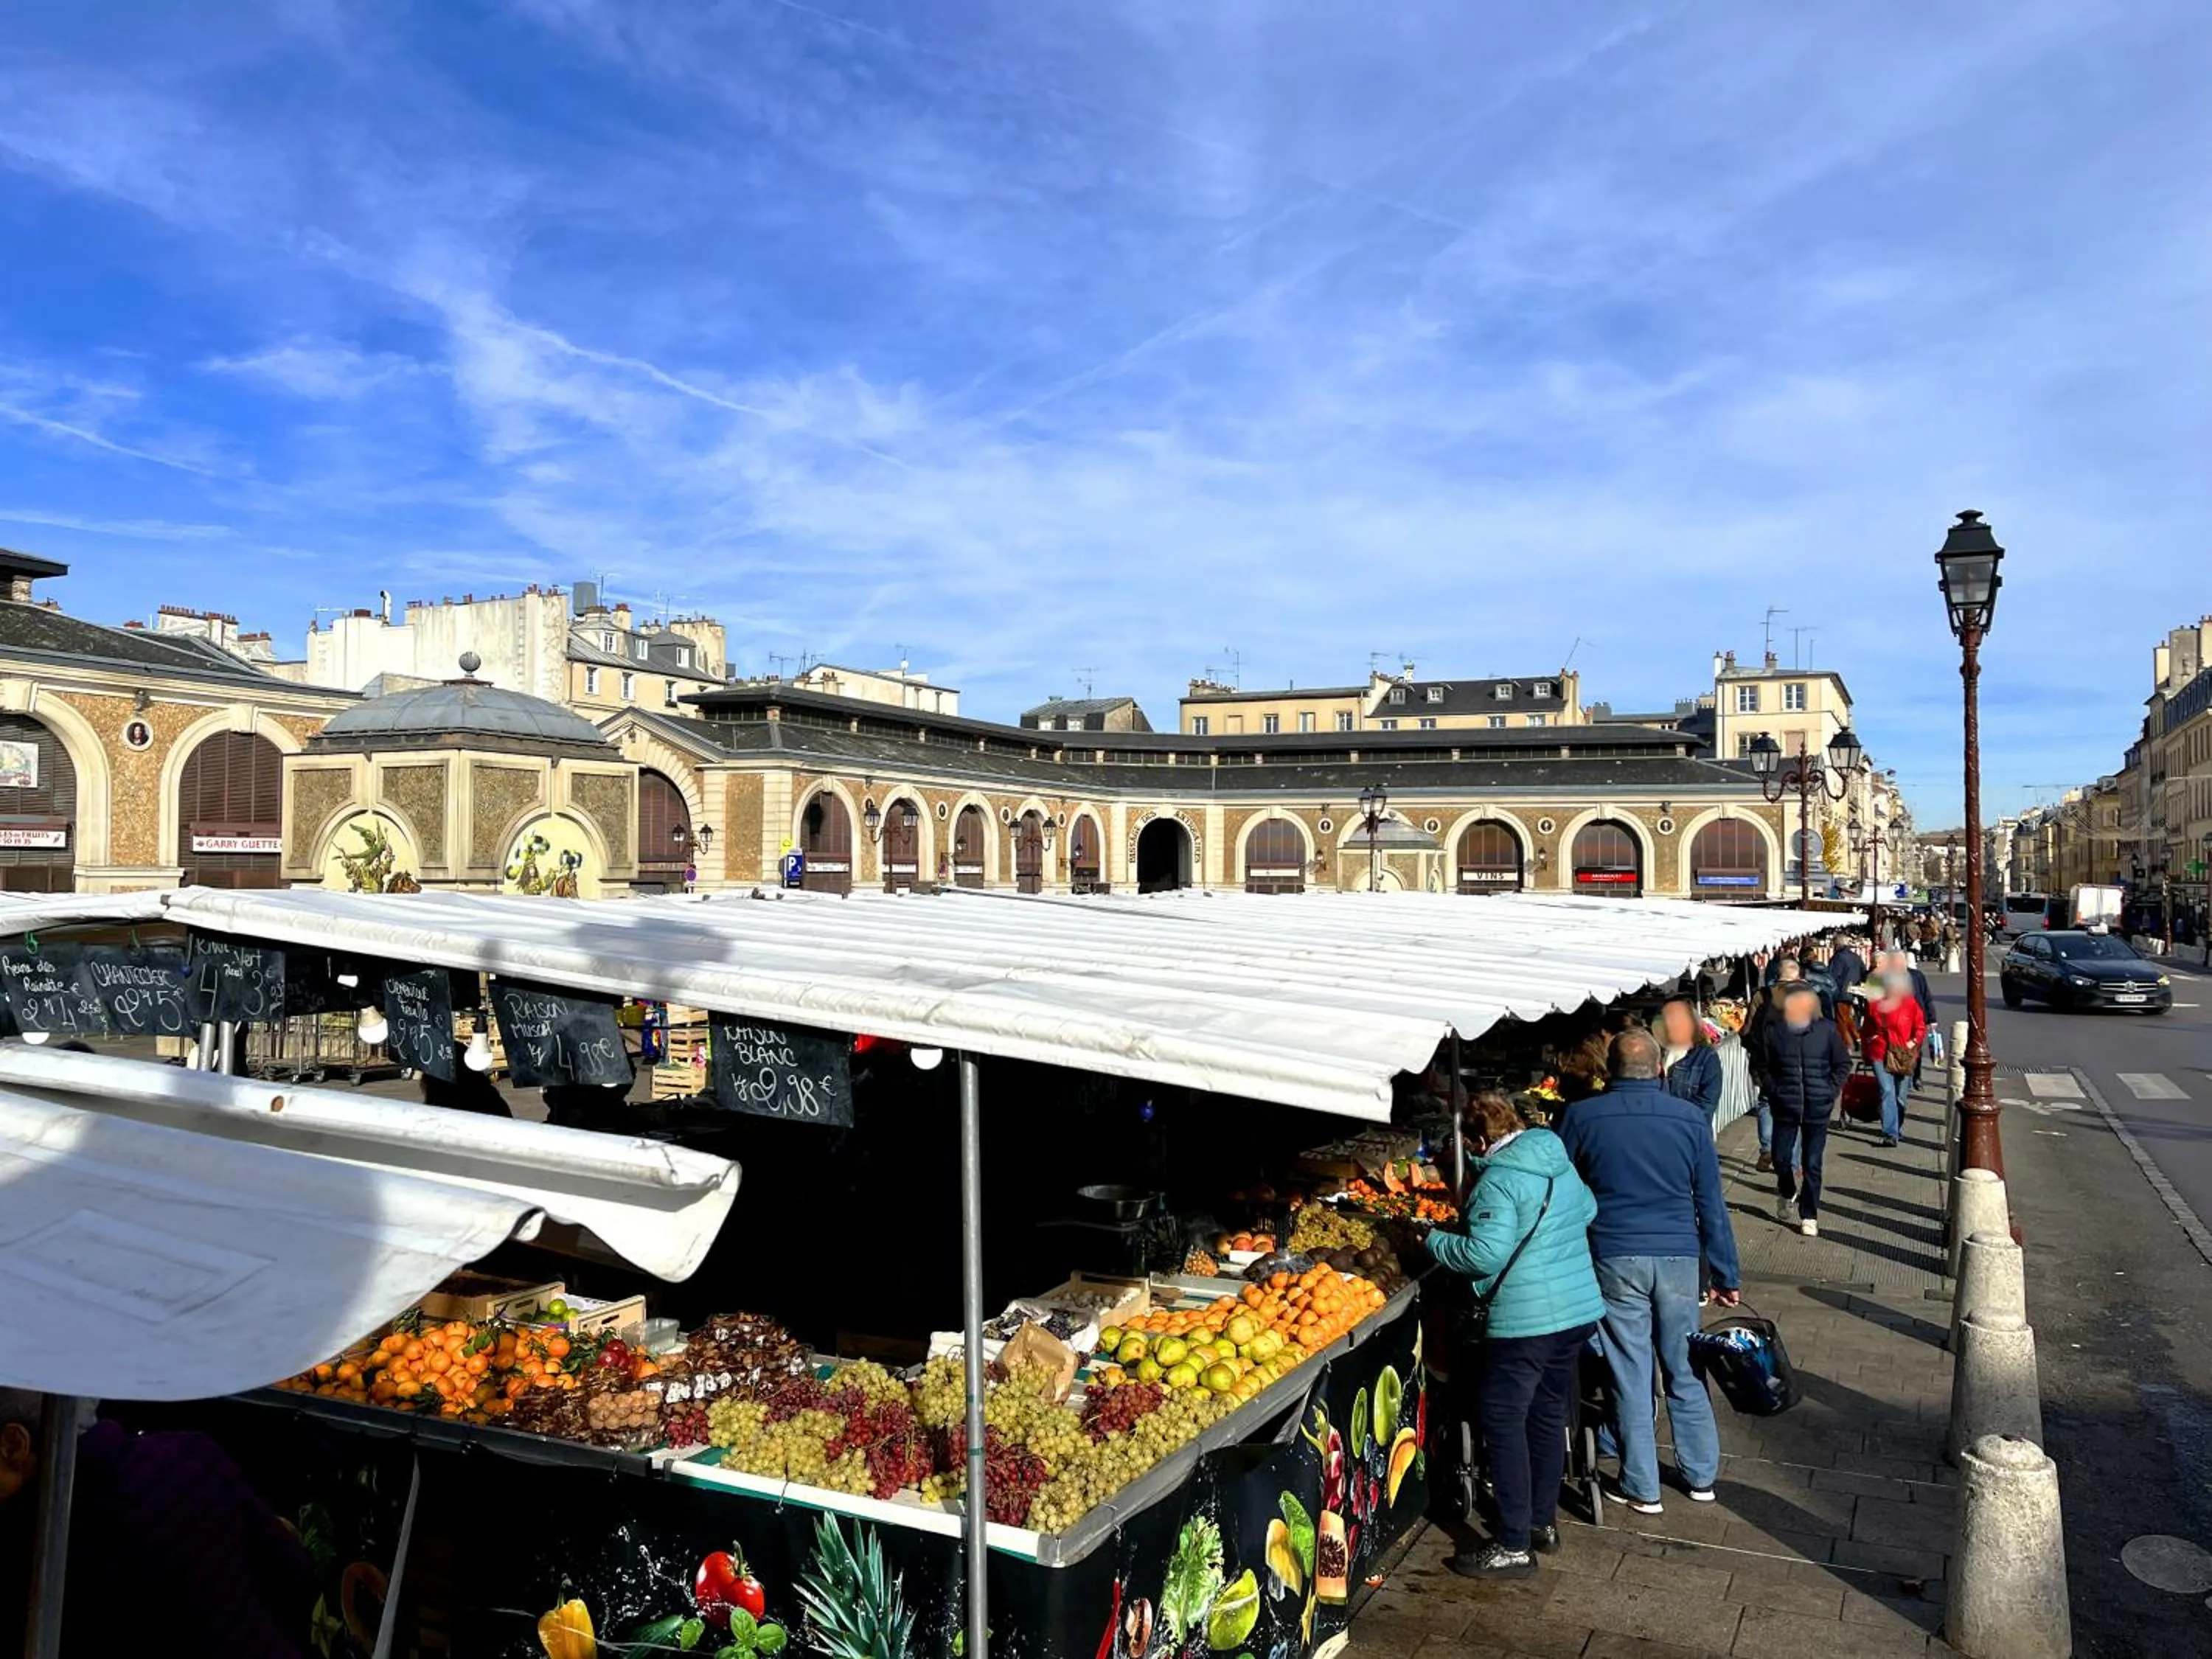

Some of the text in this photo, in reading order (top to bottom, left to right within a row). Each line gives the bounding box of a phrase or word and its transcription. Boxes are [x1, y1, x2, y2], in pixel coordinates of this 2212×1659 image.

[206, 839, 278, 849] GARRY GUETTE
[1477, 871, 1505, 880] VINS
[734, 1042, 799, 1067] BLANC
